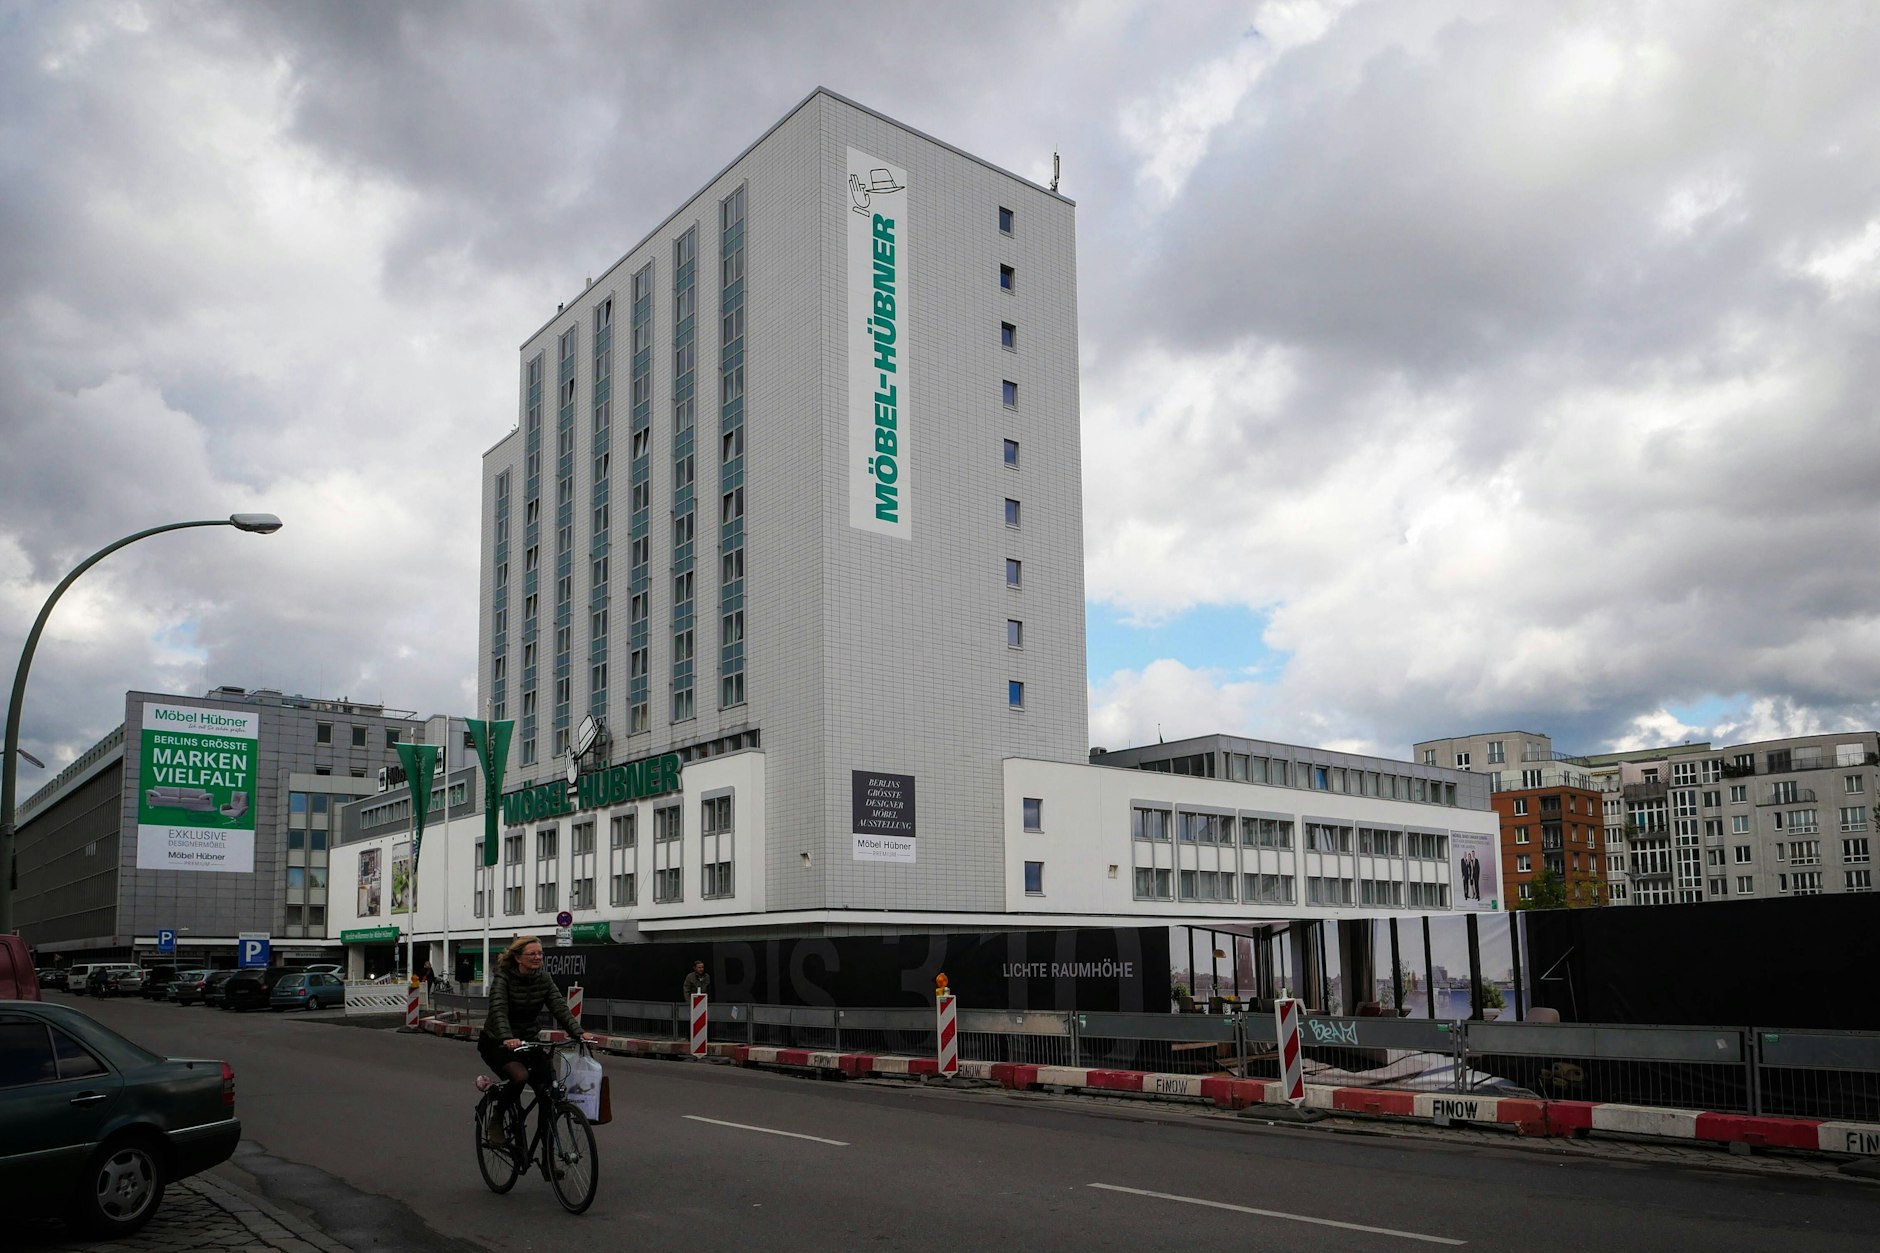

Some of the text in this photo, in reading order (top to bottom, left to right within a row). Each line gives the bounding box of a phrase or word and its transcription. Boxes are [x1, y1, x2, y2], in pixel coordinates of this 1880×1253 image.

[867, 213, 899, 524] MÖBEL-HÜBNER
[155, 709, 248, 728] Möbel Hübner
[154, 735, 248, 751] BERLINS GRÖSSTE
[153, 747, 247, 771] MARKEN
[152, 766, 246, 788] VIELFALT
[869, 779, 901, 788] BERLINS
[503, 753, 683, 827] MÖBEL-HÜBNER
[867, 788, 902, 799] GRÖSSTE
[865, 799, 904, 809] DESIGNER
[872, 809, 898, 819] MÖBEL
[858, 819, 912, 830] AUSSTELLUNG
[168, 829, 227, 841] EXKLUSIVE
[168, 840, 226, 849] DESIGNERMÖBEL
[857, 840, 911, 850] Möbel Hübner
[168, 851, 225, 860] Möbel Hübner
[161, 932, 172, 944] P
[246, 941, 262, 962] P
[1003, 958, 1133, 978] LICHTE RAUMHÖHE
[958, 1065, 982, 1077] FINOW
[1156, 1078, 1188, 1094] FINOW
[1433, 1100, 1478, 1119] FINOW
